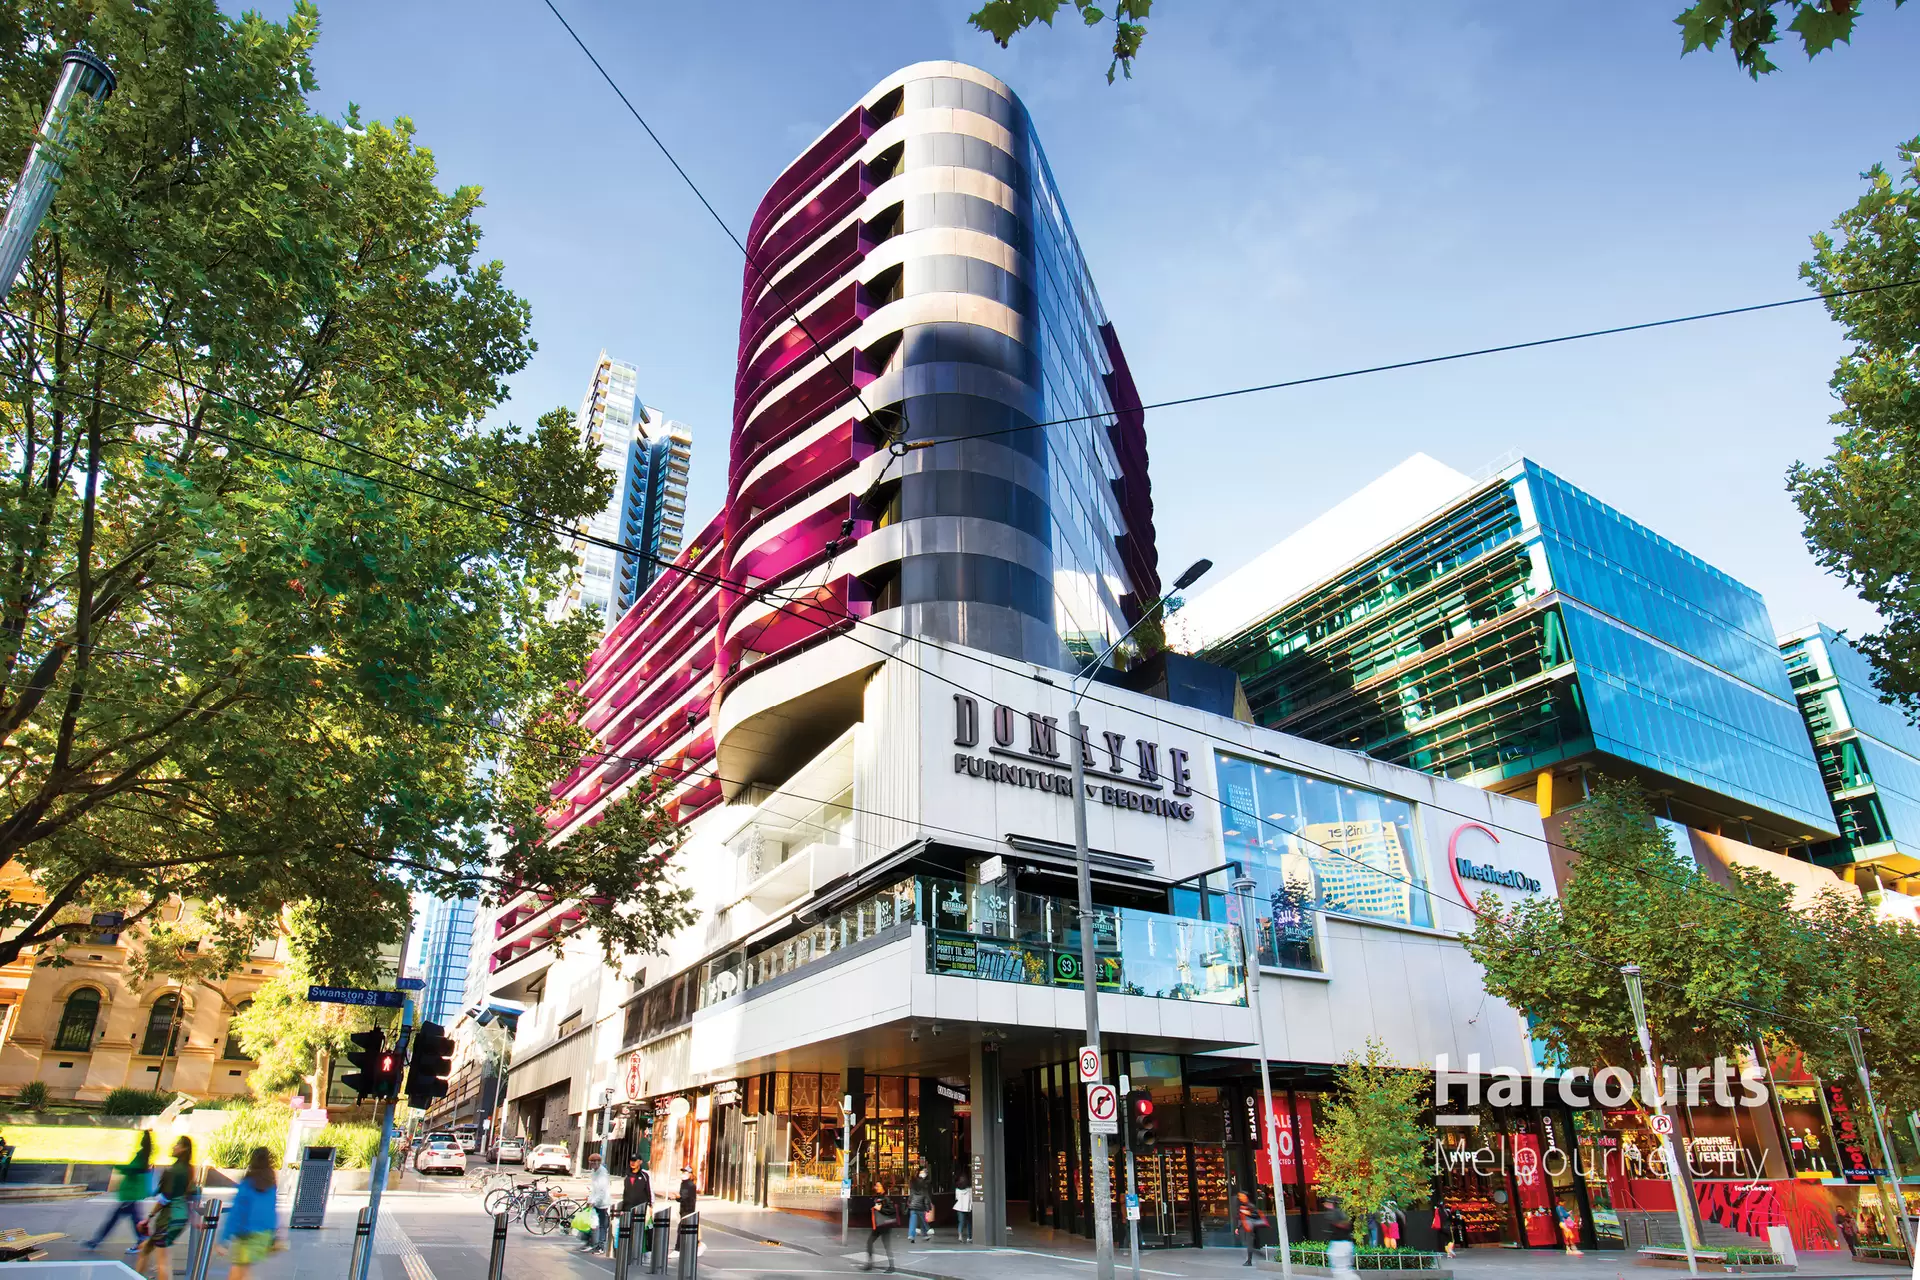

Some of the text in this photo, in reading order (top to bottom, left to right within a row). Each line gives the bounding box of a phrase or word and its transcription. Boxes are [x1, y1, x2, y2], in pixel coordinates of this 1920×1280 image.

[953, 693, 1192, 797] DOMAYNE
[954, 753, 1074, 798] FURNITUR
[1102, 785, 1194, 821] BEDDING
[1455, 857, 1541, 893] MedicalOne
[311, 987, 379, 1001] Swanston St
[1083, 1057, 1096, 1070] 30
[1248, 1108, 1257, 1142] HYPE
[1545, 1125, 1556, 1152] HYPE
[1449, 1151, 1478, 1163] HYPE
